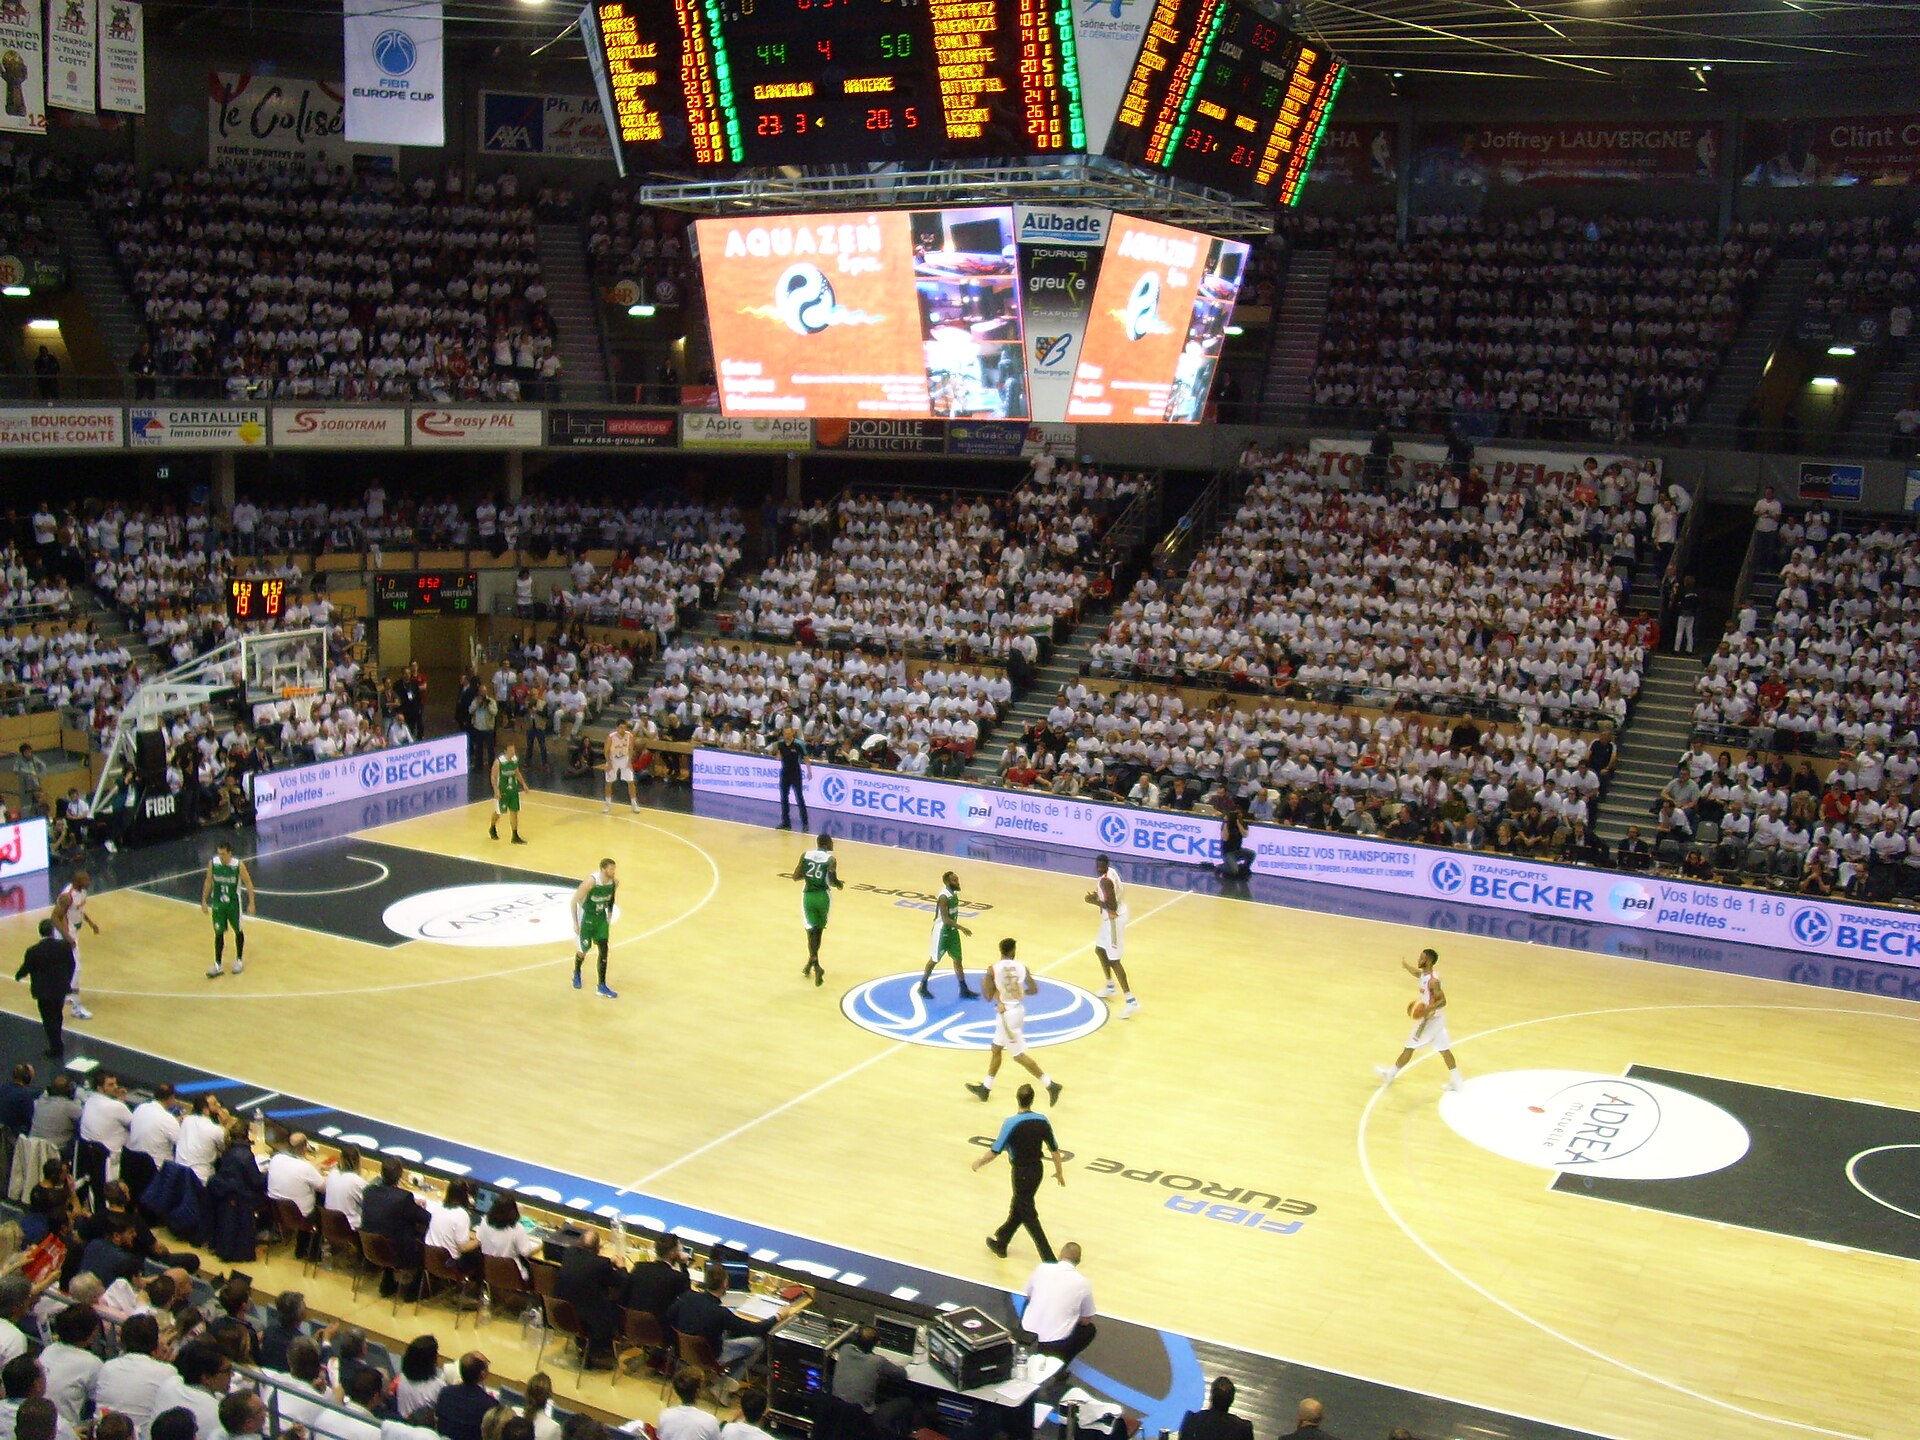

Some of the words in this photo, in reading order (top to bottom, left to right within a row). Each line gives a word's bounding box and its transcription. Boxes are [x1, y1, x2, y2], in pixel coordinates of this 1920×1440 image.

[676, 0, 682, 11] 0
[1021, 0, 1030, 11] 8
[678, 11, 686, 25] 3
[1020, 13, 1032, 26] 10
[681, 25, 687, 37] 7
[1022, 29, 1033, 41] 14
[53, 34, 93, 49] CHAMPION
[683, 39, 690, 52] 9
[757, 44, 785, 65] 44
[818, 40, 831, 60] 4
[880, 33, 910, 58] 50
[1024, 44, 1035, 57] 19
[683, 53, 693, 66] 10
[1021, 59, 1037, 73] 20
[682, 68, 697, 80] 21
[1023, 74, 1040, 87] 21
[379, 79, 409, 88] FIBA
[684, 82, 698, 94] 22
[353, 89, 405, 99] EUROPE
[410, 91, 434, 101] CUP
[687, 95, 701, 108] 23
[1025, 90, 1041, 103] 24
[689, 109, 704, 122] 24
[1027, 105, 1043, 118] 26
[1069, 103, 1081, 117] 5
[29, 114, 47, 127] 12
[758, 115, 779, 135] 23
[797, 114, 806, 134] 3
[867, 109, 889, 129] 20
[905, 108, 917, 128] 5
[1028, 120, 1045, 133] 27
[692, 122, 706, 135] 28
[1830, 125, 1894, 147] Clint
[486, 126, 530, 149] AXA
[694, 136, 707, 149] 99
[1038, 135, 1047, 147] 0
[1481, 130, 1553, 152] Joffrey
[1560, 129, 1691, 149] LAUVERGNE
[697, 149, 710, 163] 99
[1022, 212, 1101, 232] Aubade
[1032, 249, 1088, 258] TOURNUS
[1034, 367, 1070, 377] Bourgogne
[31, 416, 114, 427] BOURGOGNE
[169, 412, 258, 424] CARTALLIER
[320, 420, 386, 431] SOBOTRAM
[454, 415, 486, 429] easy
[489, 414, 514, 427] PAL
[706, 417, 742, 432] Apic
[170, 429, 232, 438] Immobilier
[609, 421, 667, 431] architecture
[772, 419, 808, 433] Apic
[848, 420, 922, 436] DODILLE
[1320, 452, 1406, 480] TOS
[237, 596, 248, 615] 19
[266, 595, 278, 614] 19
[393, 601, 406, 610] 44
[455, 599, 467, 608] 50
[386, 749, 431, 764] TRANSPORTS
[279, 776, 297, 789] Vos
[300, 772, 317, 785] lots
[319, 769, 330, 781] de
[334, 766, 338, 777] 1
[341, 764, 347, 776] à
[350, 762, 356, 775] 6
[386, 753, 458, 784] BECKER
[853, 778, 910, 793] TRANSPORTS
[256, 790, 277, 808] pal
[280, 788, 323, 809] palettes
[852, 788, 946, 820] BECKER
[145, 795, 175, 818] FIBA
[968, 805, 992, 819] pal
[995, 795, 1017, 812] Vos
[1021, 797, 1041, 815] lots
[1045, 801, 1059, 817] de
[1063, 805, 1070, 818] 1
[1074, 808, 1081, 820] à
[1085, 808, 1092, 821] 6
[995, 814, 1048, 835] palettes
[1135, 818, 1201, 834] TRANSPORTS
[1133, 828, 1224, 860] BECKE
[1258, 843, 1310, 858] IDÉALISEZ
[1314, 848, 1335, 860] VOS
[1338, 849, 1410, 865] TRANSPORTS
[806, 862, 822, 878] 26
[1472, 864, 1548, 881] TRANSPORTS
[1469, 876, 1594, 911] BECKER
[1622, 896, 1655, 911] pal
[1660, 886, 1687, 903] Vos
[1692, 890, 1719, 909] lots
[1723, 894, 1742, 911] de
[1749, 899, 1756, 913] 1
[1761, 899, 1770, 916] à
[1775, 902, 1785, 917] 6
[449, 891, 573, 930] ADREA
[1657, 907, 1727, 930] palettes
[1543, 1102, 1584, 1148] mutuelle
[1554, 1093, 1637, 1165] ADREA
[1085, 1157, 1318, 1216] EUROPE
[1164, 1195, 1305, 1235] FIBA
